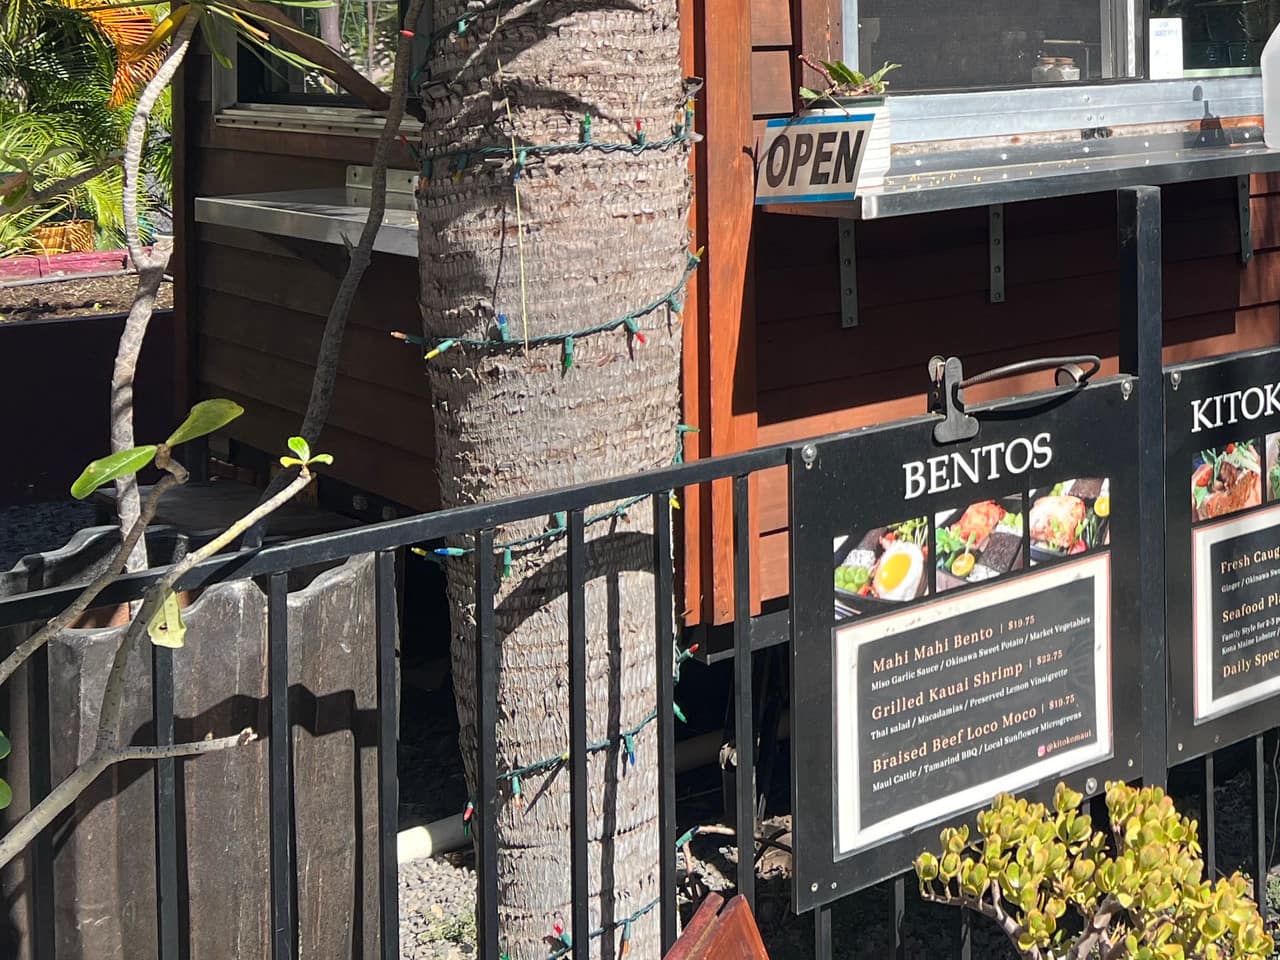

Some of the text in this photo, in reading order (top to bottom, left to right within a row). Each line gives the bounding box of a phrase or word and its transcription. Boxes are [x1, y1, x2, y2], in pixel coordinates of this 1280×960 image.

[766, 130, 865, 188] OPEN
[902, 433, 1052, 500] BENTOS
[1221, 554, 1250, 574] Fresh
[1245, 572, 1269, 585] Okinawa
[1222, 597, 1265, 623] Seafood
[871, 616, 1091, 691] Miso Garlic Sauce Okinawa Sweet Potato Market Vegetables
[872, 650, 908, 673] Mahi
[914, 638, 948, 661] Mahi
[954, 628, 993, 649] Bento
[1223, 658, 1251, 678] Daily
[870, 668, 1068, 740] Thai salad Macadamias Preserved Lemon Vinaigrette
[872, 691, 924, 720] Grilled
[929, 677, 969, 703] Kauai
[973, 663, 1023, 688] Shrimp
[872, 741, 927, 773] Braised
[932, 729, 964, 753] Beef
[967, 721, 998, 741] Loco
[1002, 707, 1037, 729] Moco
[872, 711, 1082, 793] Maui Cattle Tamarind BBQ Local Sunflower Microgreens
